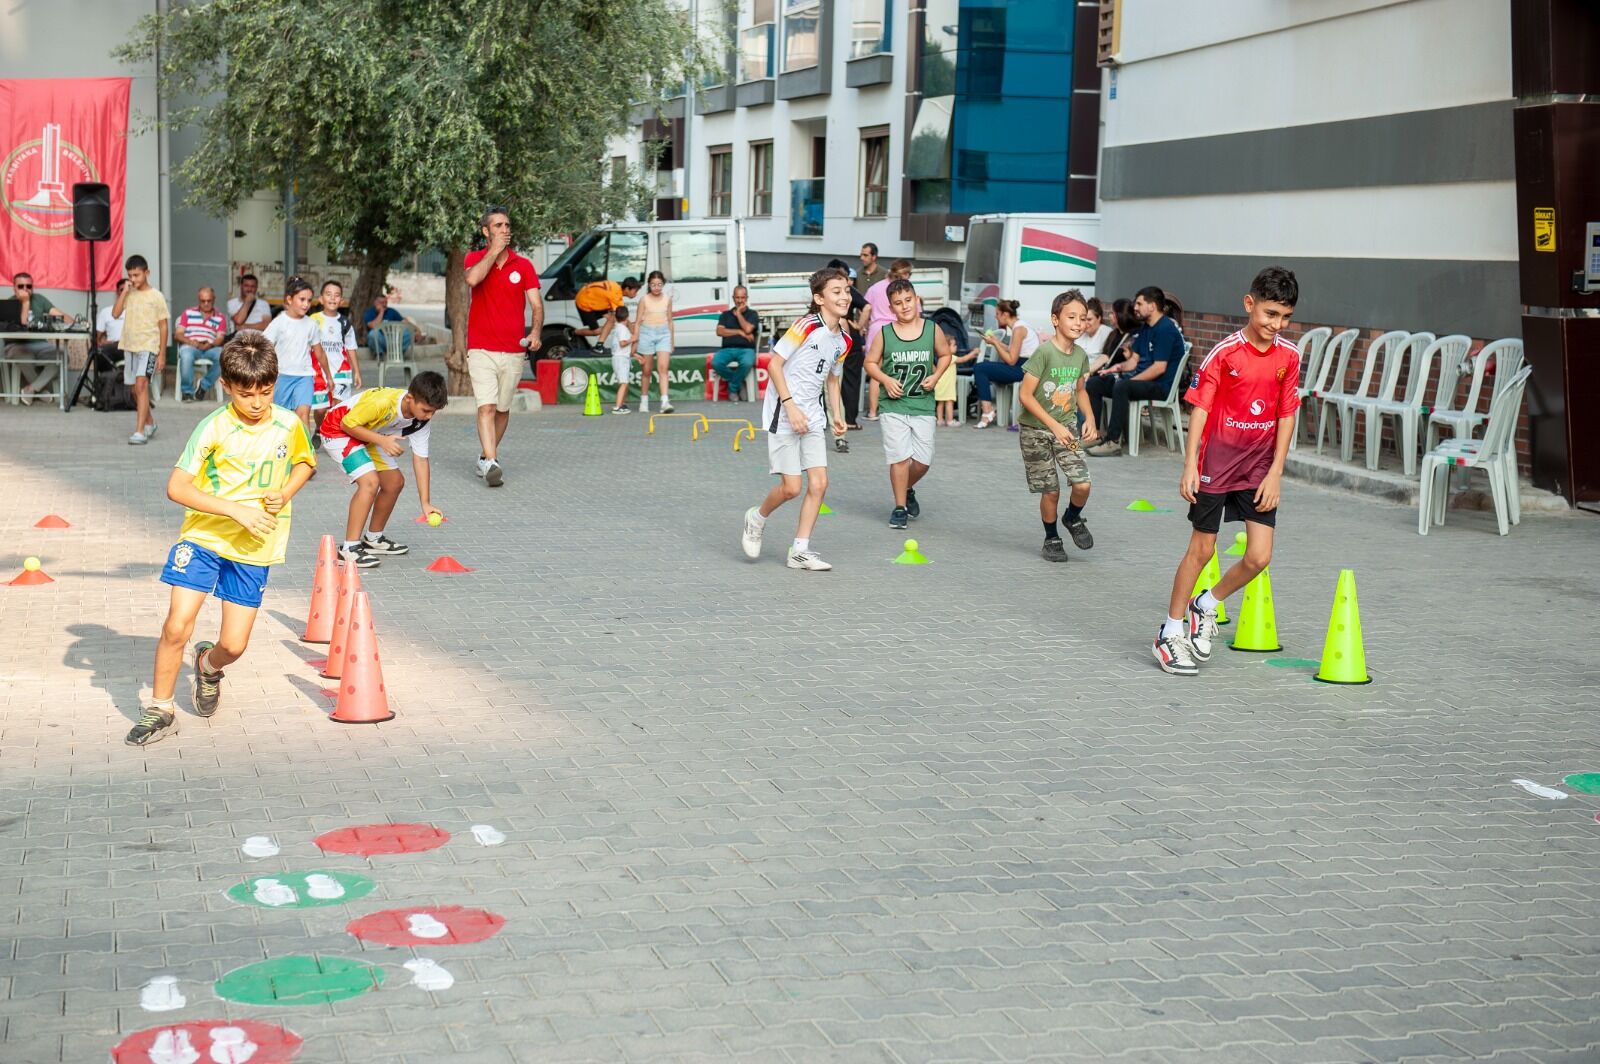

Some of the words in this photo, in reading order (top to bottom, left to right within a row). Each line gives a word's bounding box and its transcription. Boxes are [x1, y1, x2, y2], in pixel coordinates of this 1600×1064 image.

[891, 350, 930, 362] CHAMPION
[892, 363, 927, 398] 72
[246, 460, 273, 488] 10
